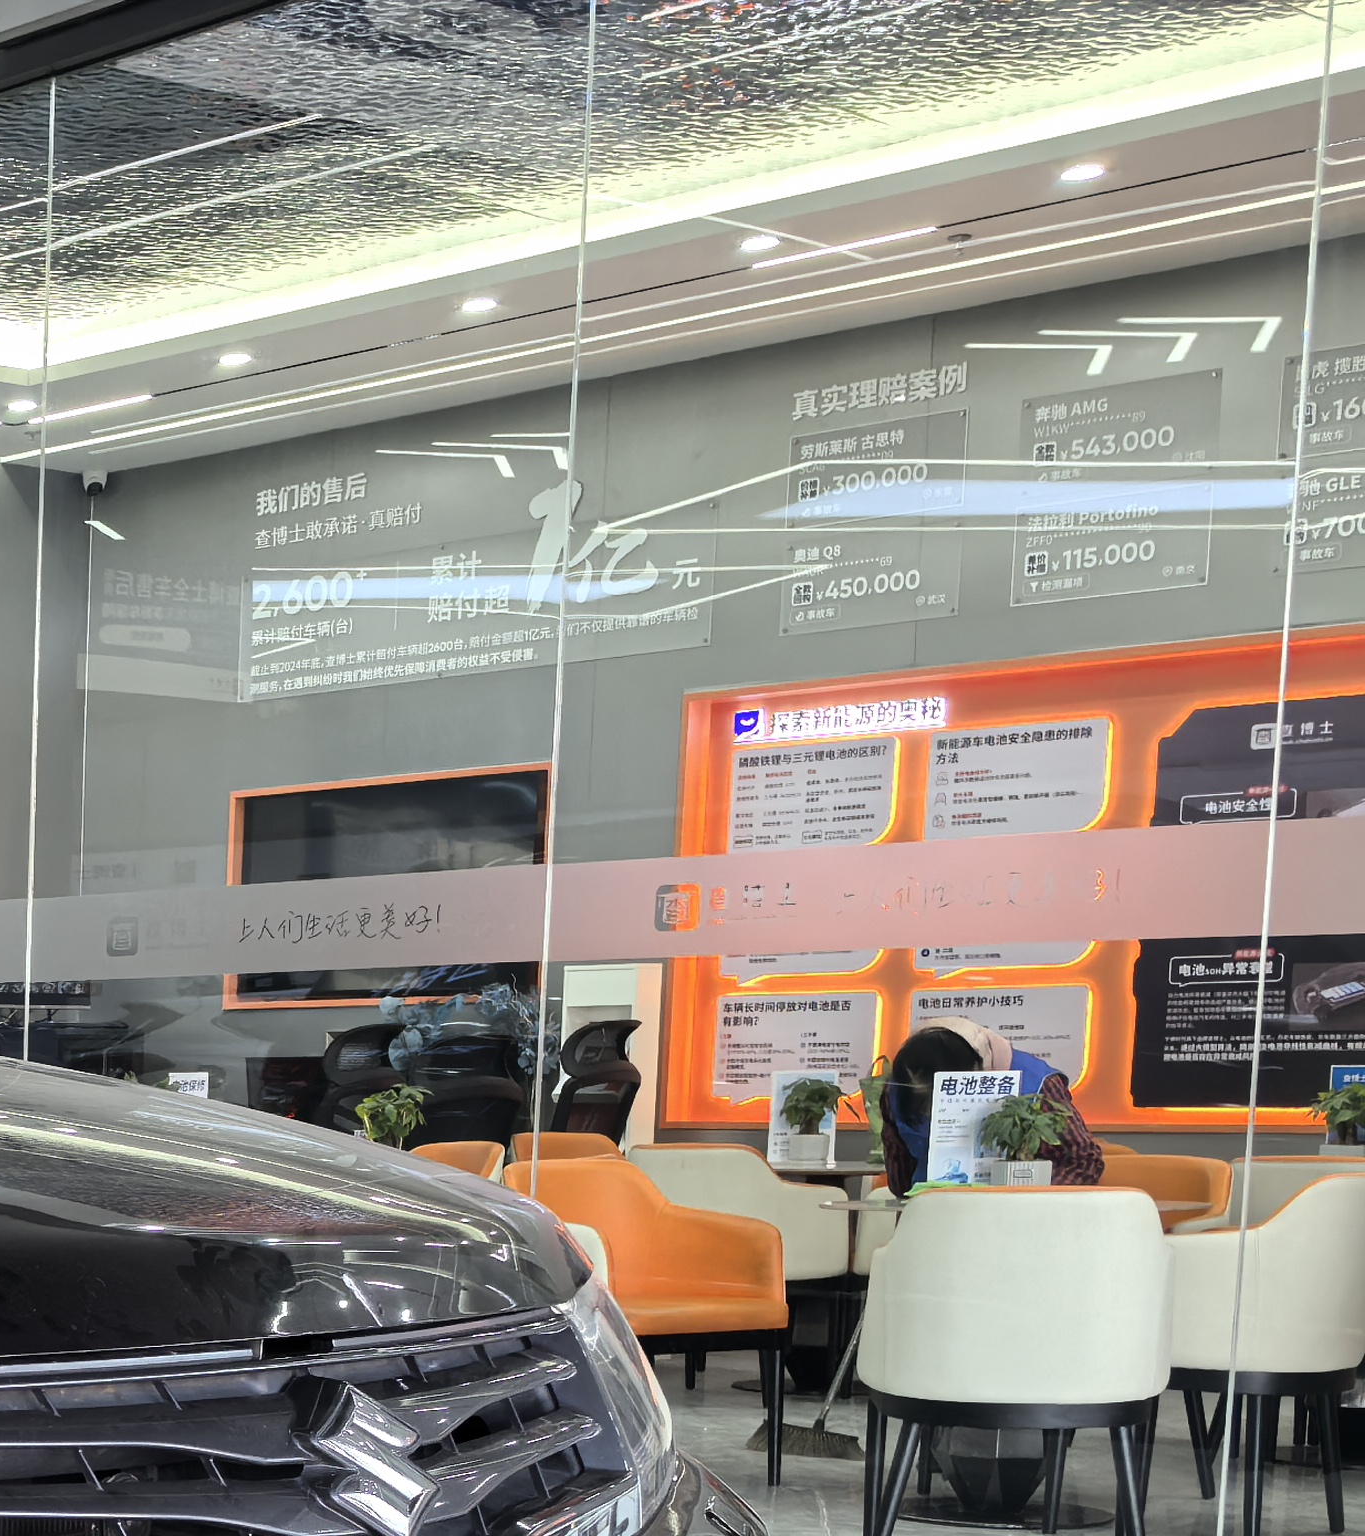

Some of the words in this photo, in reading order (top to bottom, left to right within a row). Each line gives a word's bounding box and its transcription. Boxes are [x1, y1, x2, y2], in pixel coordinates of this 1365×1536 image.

[792, 361, 968, 421] 真实理赔案例
[1035, 403, 1068, 424] 奔驰
[1070, 398, 1109, 418] AMG
[861, 429, 905, 451] 古思特
[1060, 425, 1175, 462] ¥543,000
[256, 472, 369, 517] 我们的售后
[822, 463, 929, 497] ¥300,000
[1325, 475, 1362, 493] GLE
[1027, 511, 1075, 533] 法拉利
[1078, 504, 1160, 526] Portofino
[822, 544, 842, 561] Q8
[1051, 540, 1156, 572] ¥115,000
[429, 552, 483, 587] 累计
[815, 569, 921, 602] ¥450,000
[427, 584, 511, 624] 赔付超
[767, 698, 947, 738] 探索新能源的奥秘
[936, 726, 1093, 751] 新能源车电池安全隐患的排除
[935, 752, 959, 766] 方法
[723, 1000, 852, 1014] 车辆长时间停放对电池是否
[918, 994, 1025, 1010] 电池日常养护小技巧
[940, 1075, 1015, 1096] 电池整备
